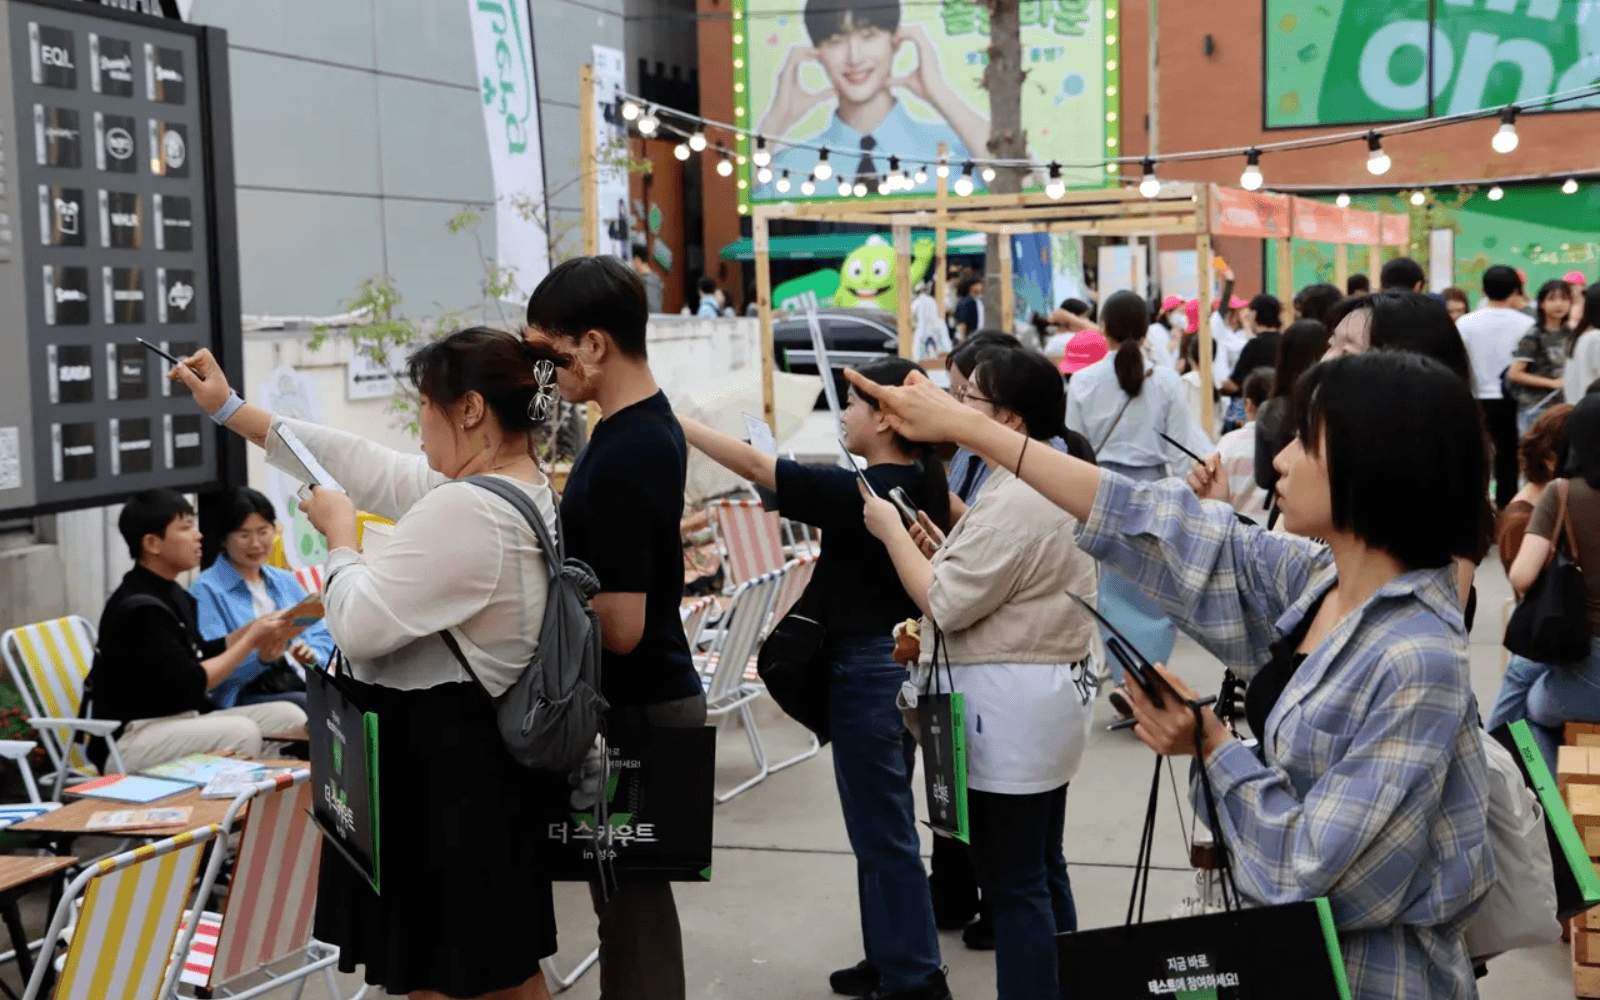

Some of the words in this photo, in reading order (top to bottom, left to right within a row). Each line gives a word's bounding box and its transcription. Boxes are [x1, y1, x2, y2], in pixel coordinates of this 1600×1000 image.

[41, 44, 75, 68] EQL
[548, 822, 569, 845] 더
[572, 820, 659, 847] 스카우트
[1166, 956, 1187, 972] 지금
[1186, 953, 1210, 970] 바로
[1148, 977, 1187, 995] 테스트에
[1186, 972, 1240, 991] 참여하세요!
